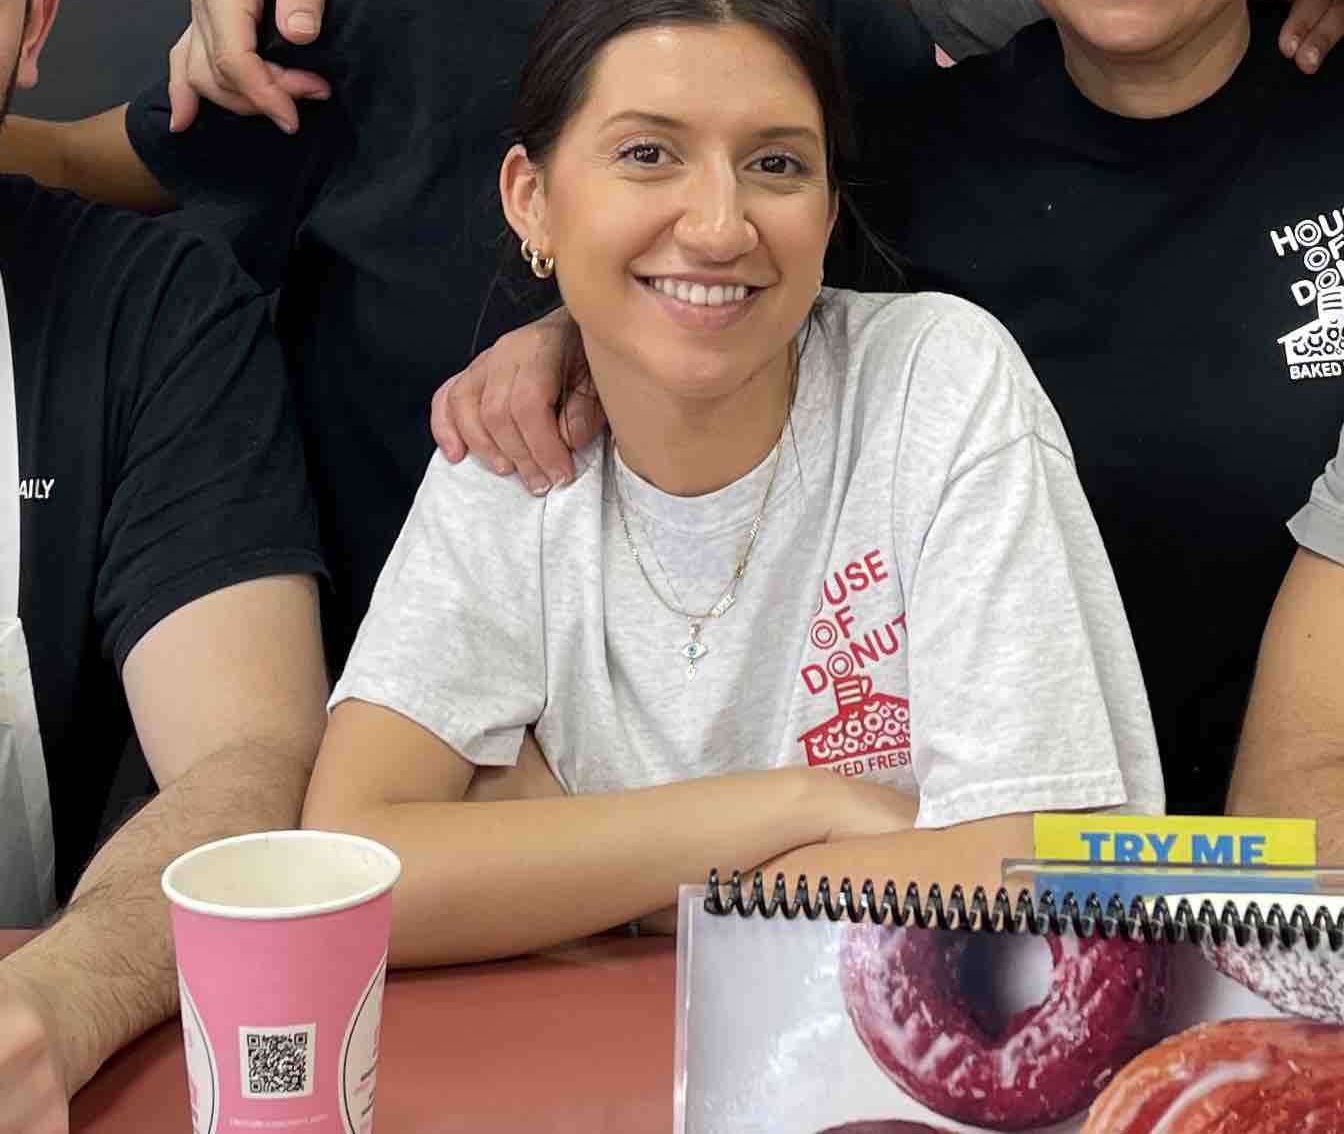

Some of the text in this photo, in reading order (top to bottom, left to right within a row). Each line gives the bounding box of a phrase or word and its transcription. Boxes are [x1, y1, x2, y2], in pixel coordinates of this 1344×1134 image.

[1289, 362, 1342, 380] BAKED
[17, 478, 55, 500] AILY
[818, 549, 889, 611] USE
[811, 605, 856, 650] OF
[800, 611, 907, 696] DONUT
[832, 759, 865, 778] KED
[1079, 831, 1267, 867] TRY ME
